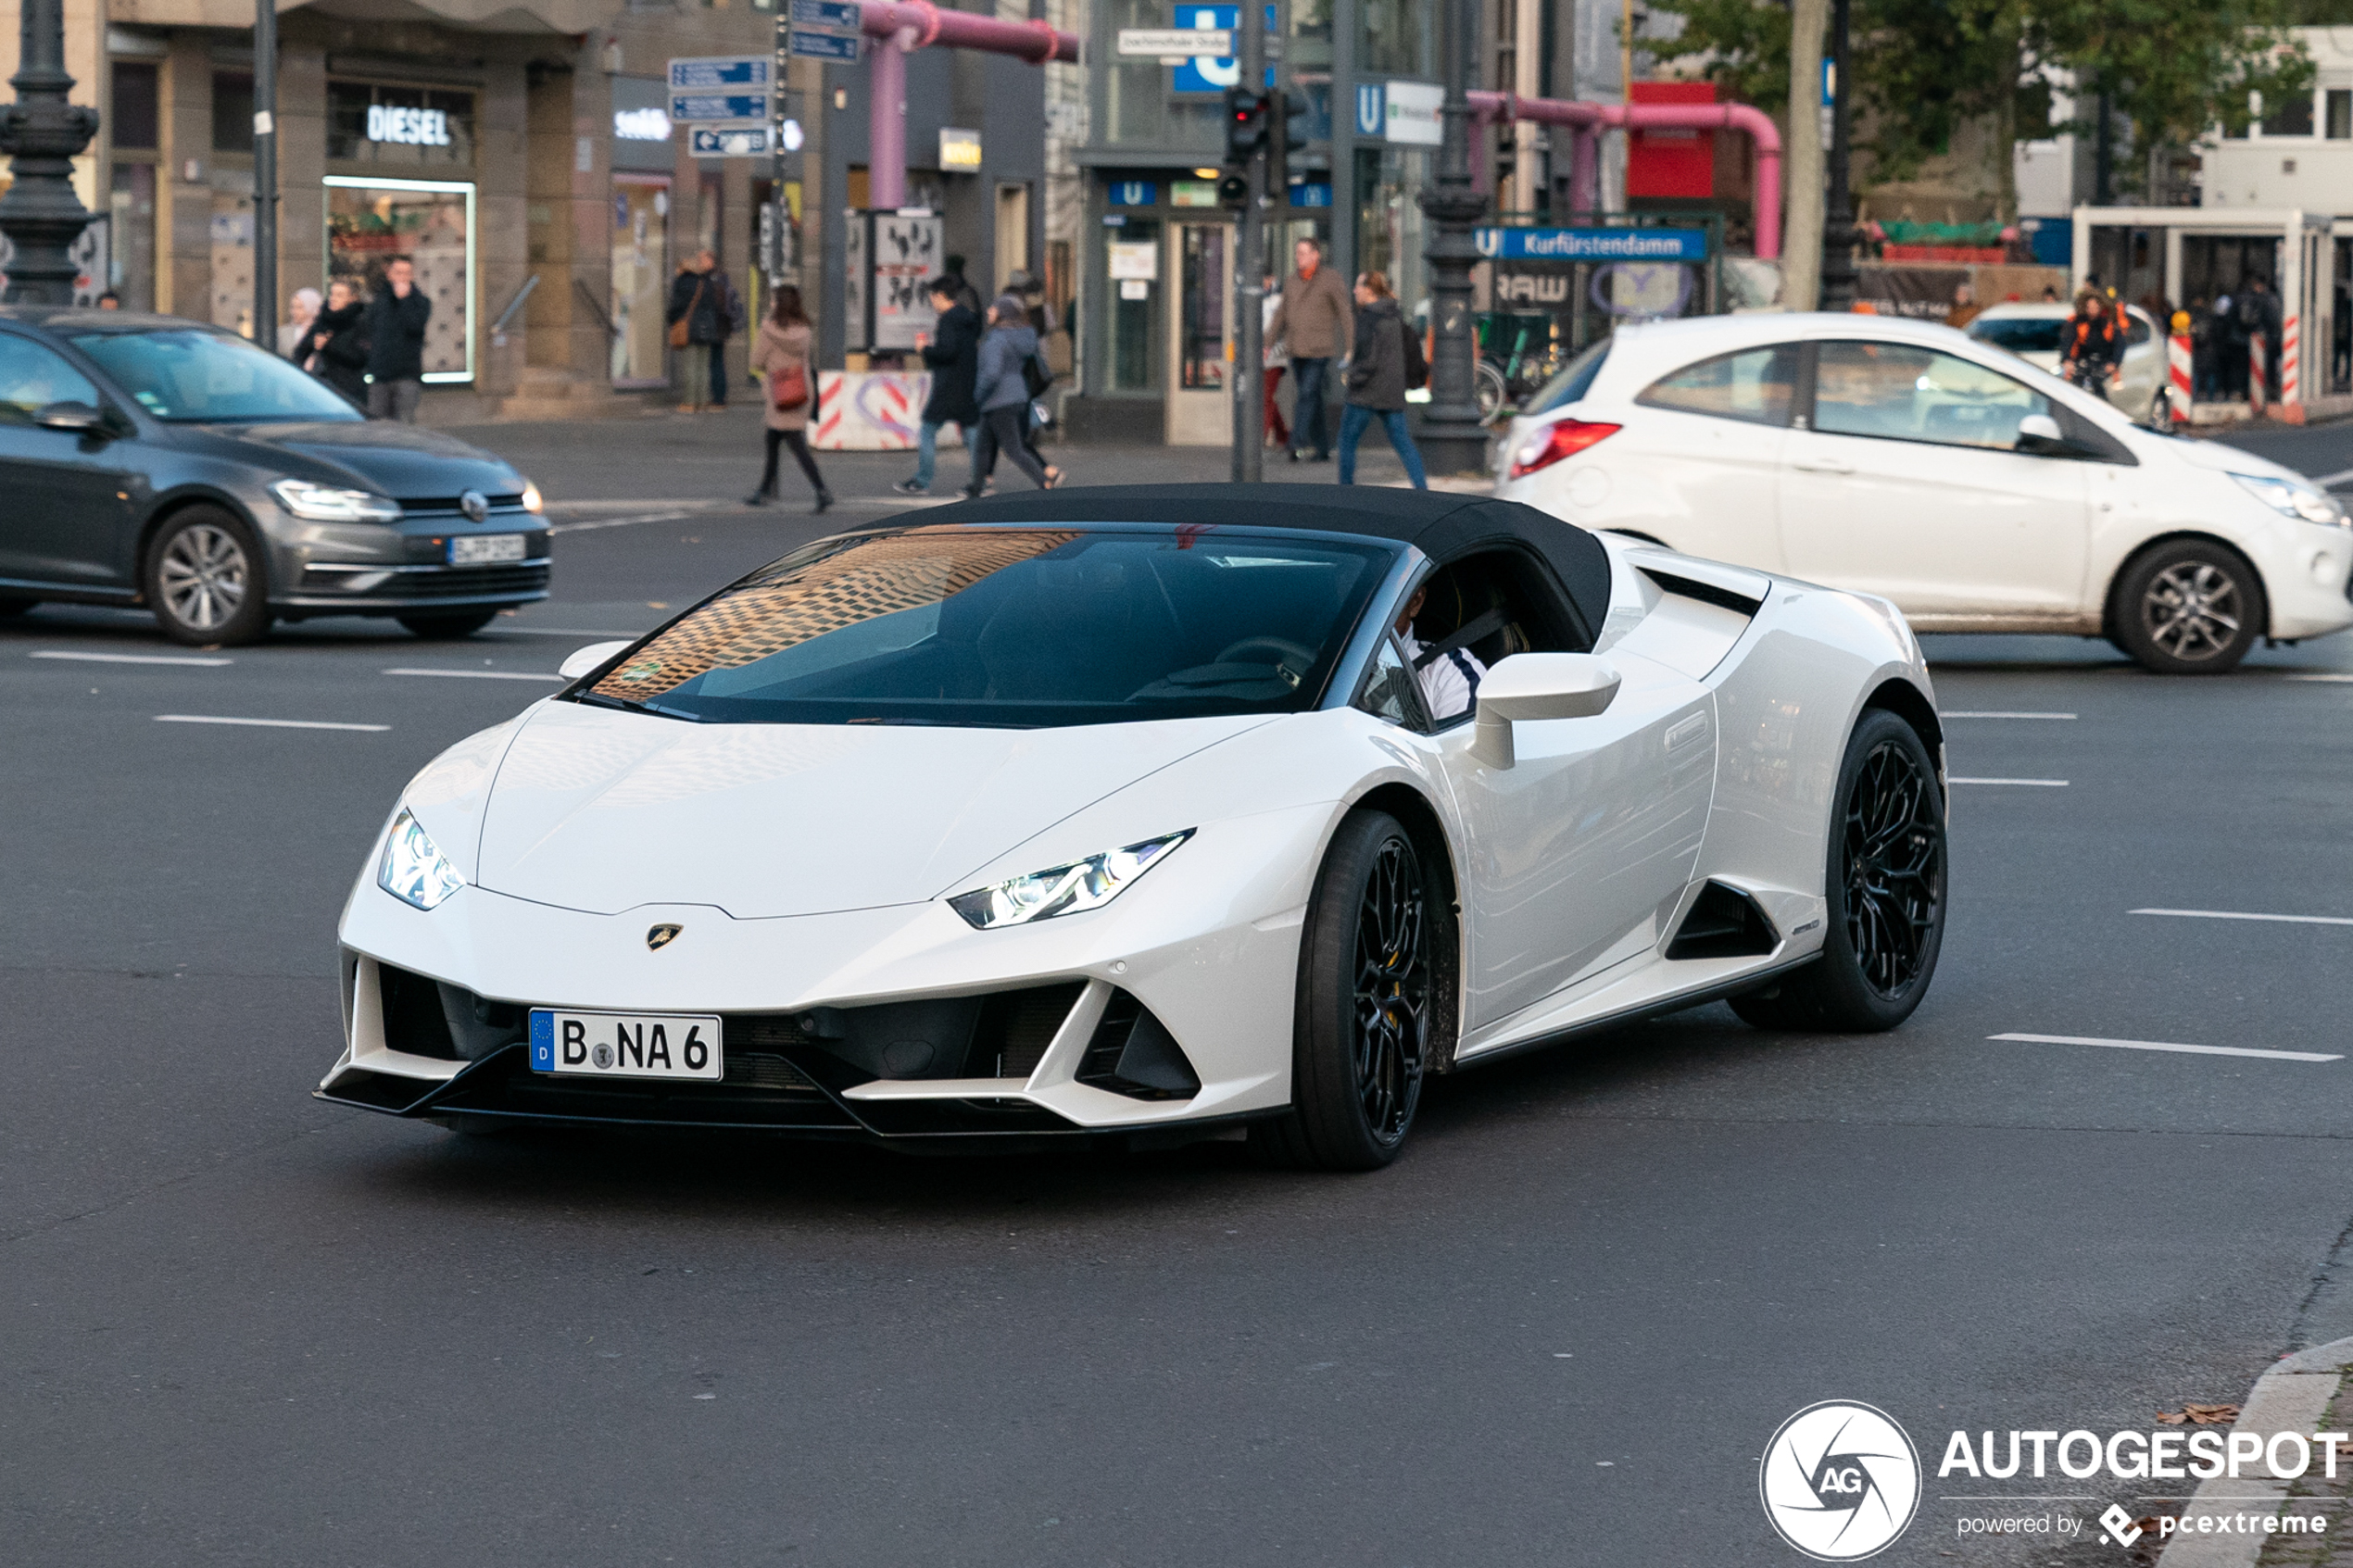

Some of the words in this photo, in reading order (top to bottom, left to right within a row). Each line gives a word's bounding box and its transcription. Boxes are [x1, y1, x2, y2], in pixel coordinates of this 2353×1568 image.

[1359, 85, 1380, 132] U
[368, 105, 449, 145] DIESEL
[1124, 182, 1143, 205] U
[1524, 232, 1683, 256] Kurfürstendamm
[539, 1047, 547, 1060] D
[562, 1020, 587, 1065] B
[617, 1022, 672, 1070] NA
[684, 1025, 708, 1070] 6
